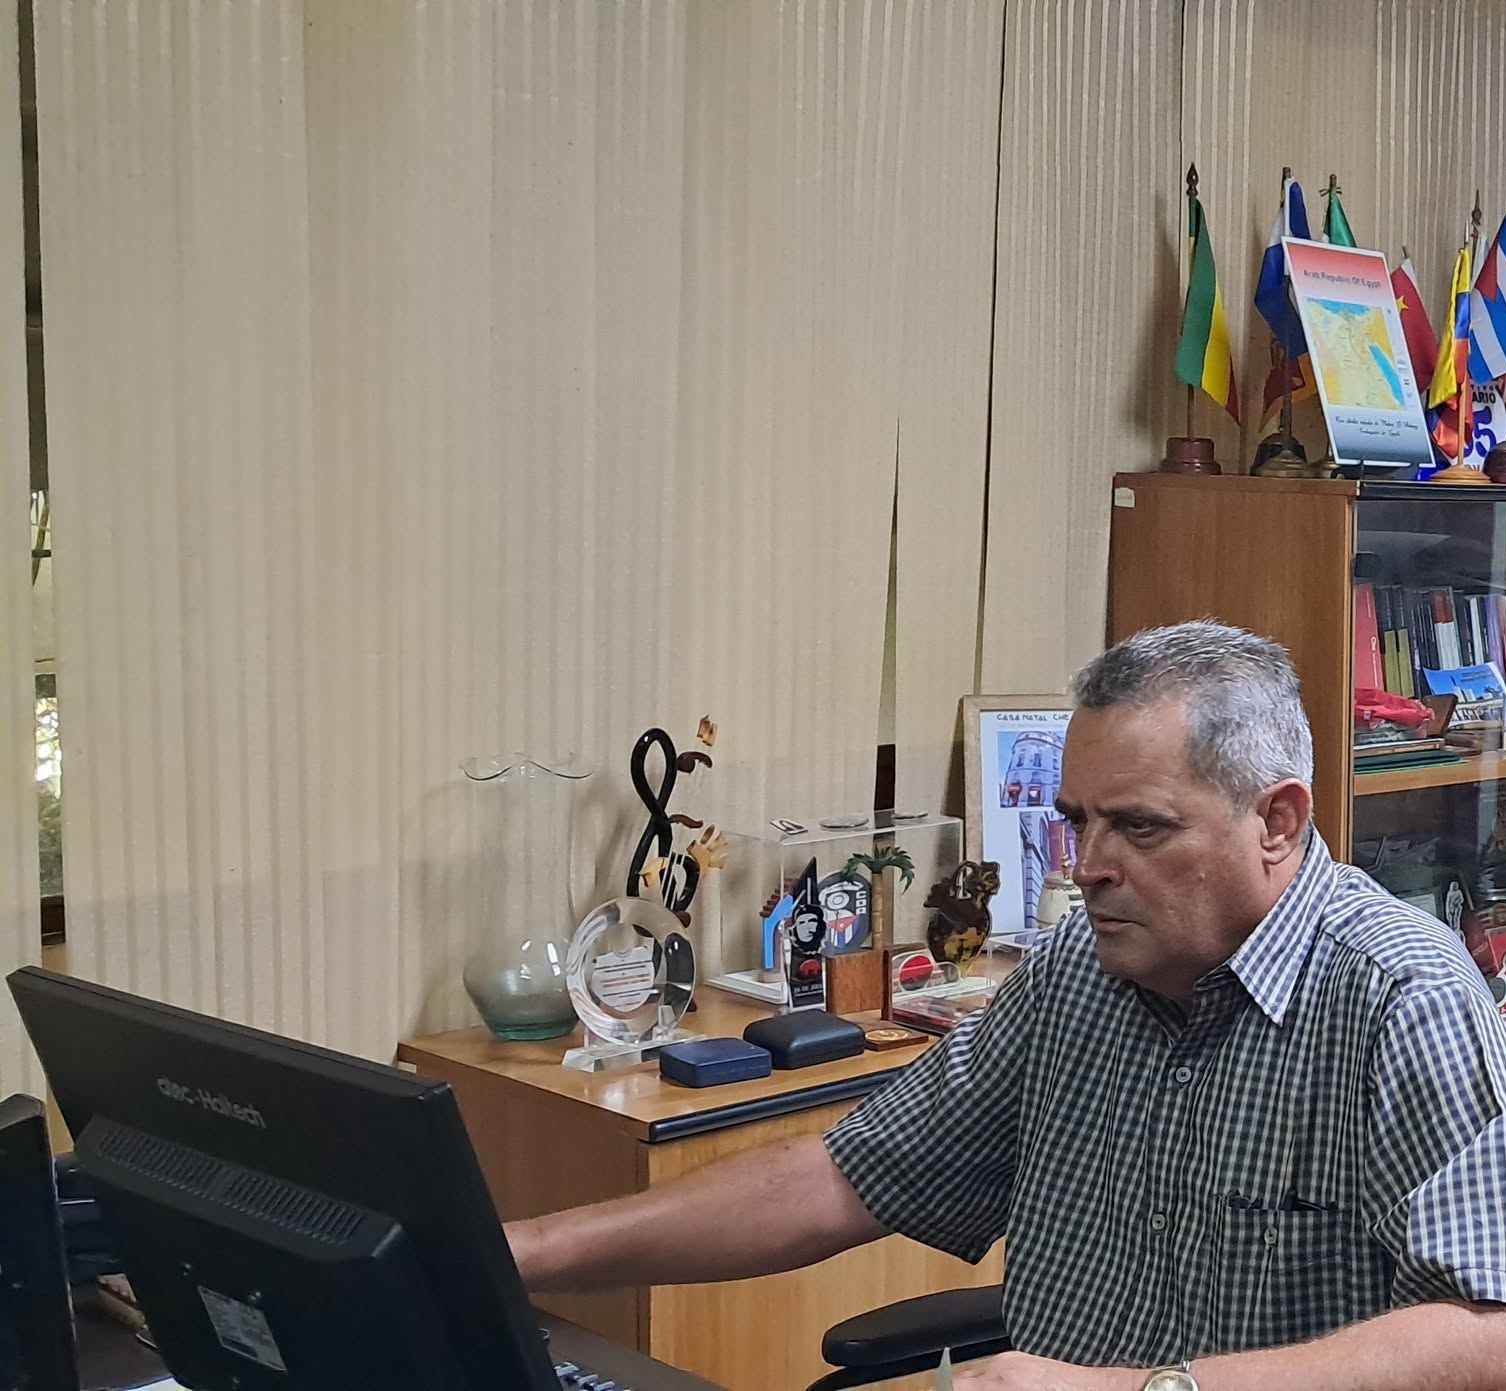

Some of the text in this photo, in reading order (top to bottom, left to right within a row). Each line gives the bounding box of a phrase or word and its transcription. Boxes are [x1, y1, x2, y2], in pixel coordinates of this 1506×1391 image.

[1321, 271, 1351, 284] Republic
[1472, 391, 1496, 404] ARIO
[1022, 713, 1047, 722] NATAL
